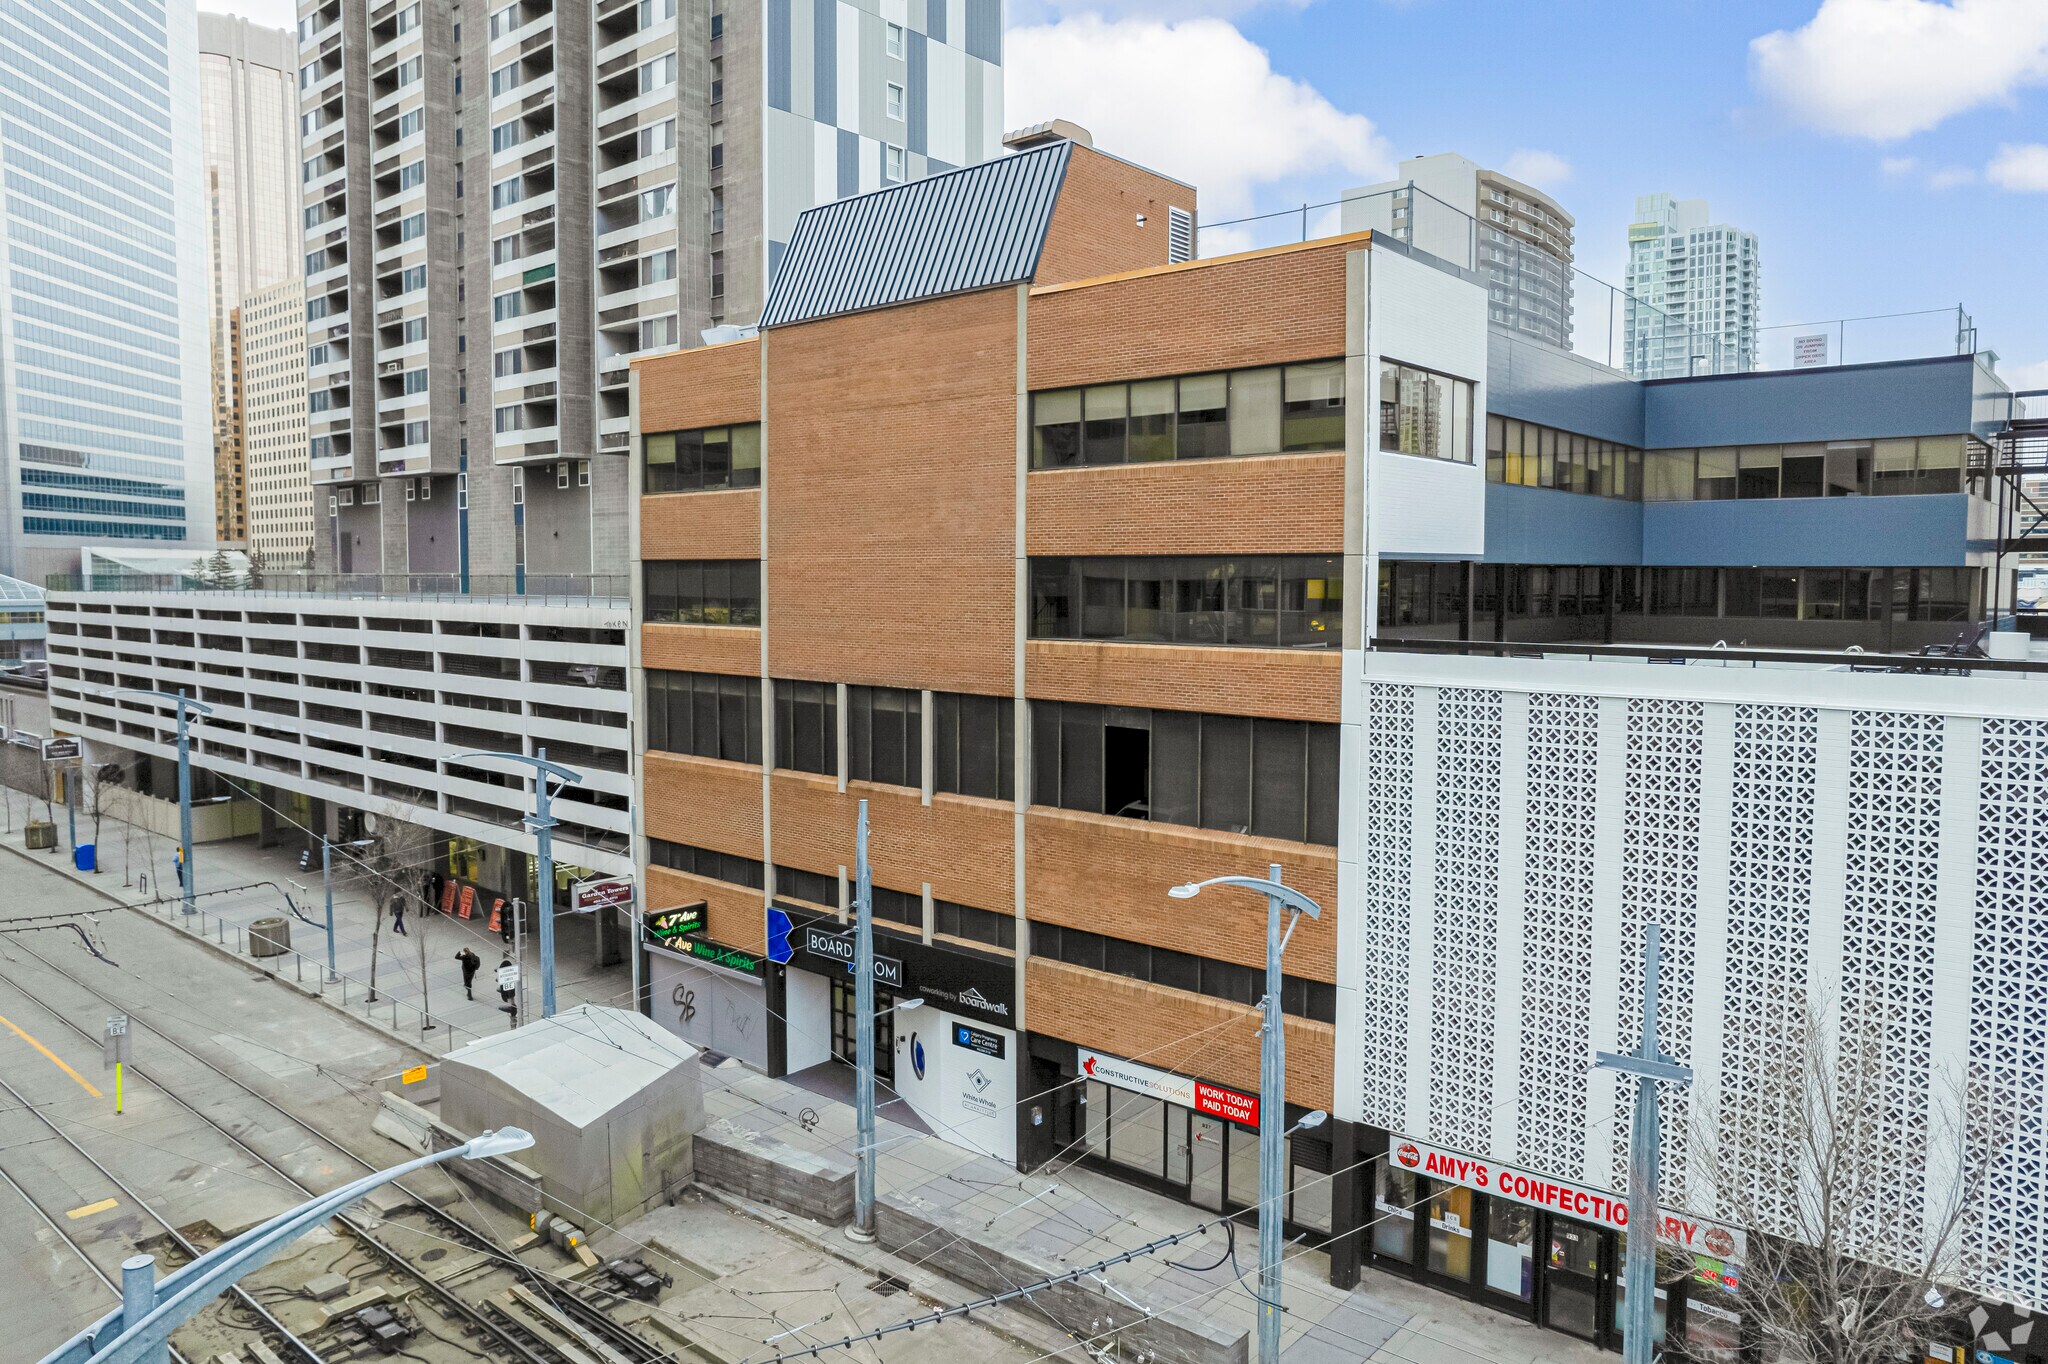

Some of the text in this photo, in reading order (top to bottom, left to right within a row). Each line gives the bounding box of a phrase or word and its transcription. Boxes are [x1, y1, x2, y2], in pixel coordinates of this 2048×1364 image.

[582, 890, 606, 899] Garden
[679, 911, 698, 922] Ave
[679, 921, 701, 933] Spirits
[674, 936, 692, 951] Ave
[694, 942, 715, 958] Wine
[717, 949, 723, 960] &
[725, 952, 755, 971] Spirits
[920, 985, 957, 1001] coworking by
[960, 992, 1008, 1016] boardwalk
[970, 1036, 981, 1045] Care
[982, 1040, 998, 1049] Centre
[962, 1092, 996, 1108] White Whale
[1199, 1086, 1253, 1109] WORK TODAY
[1202, 1099, 1250, 1120] PAID TODAY
[1425, 1152, 1698, 1245] AMY'S CONFECTIORY
[1442, 1222, 1460, 1234] Drinks
